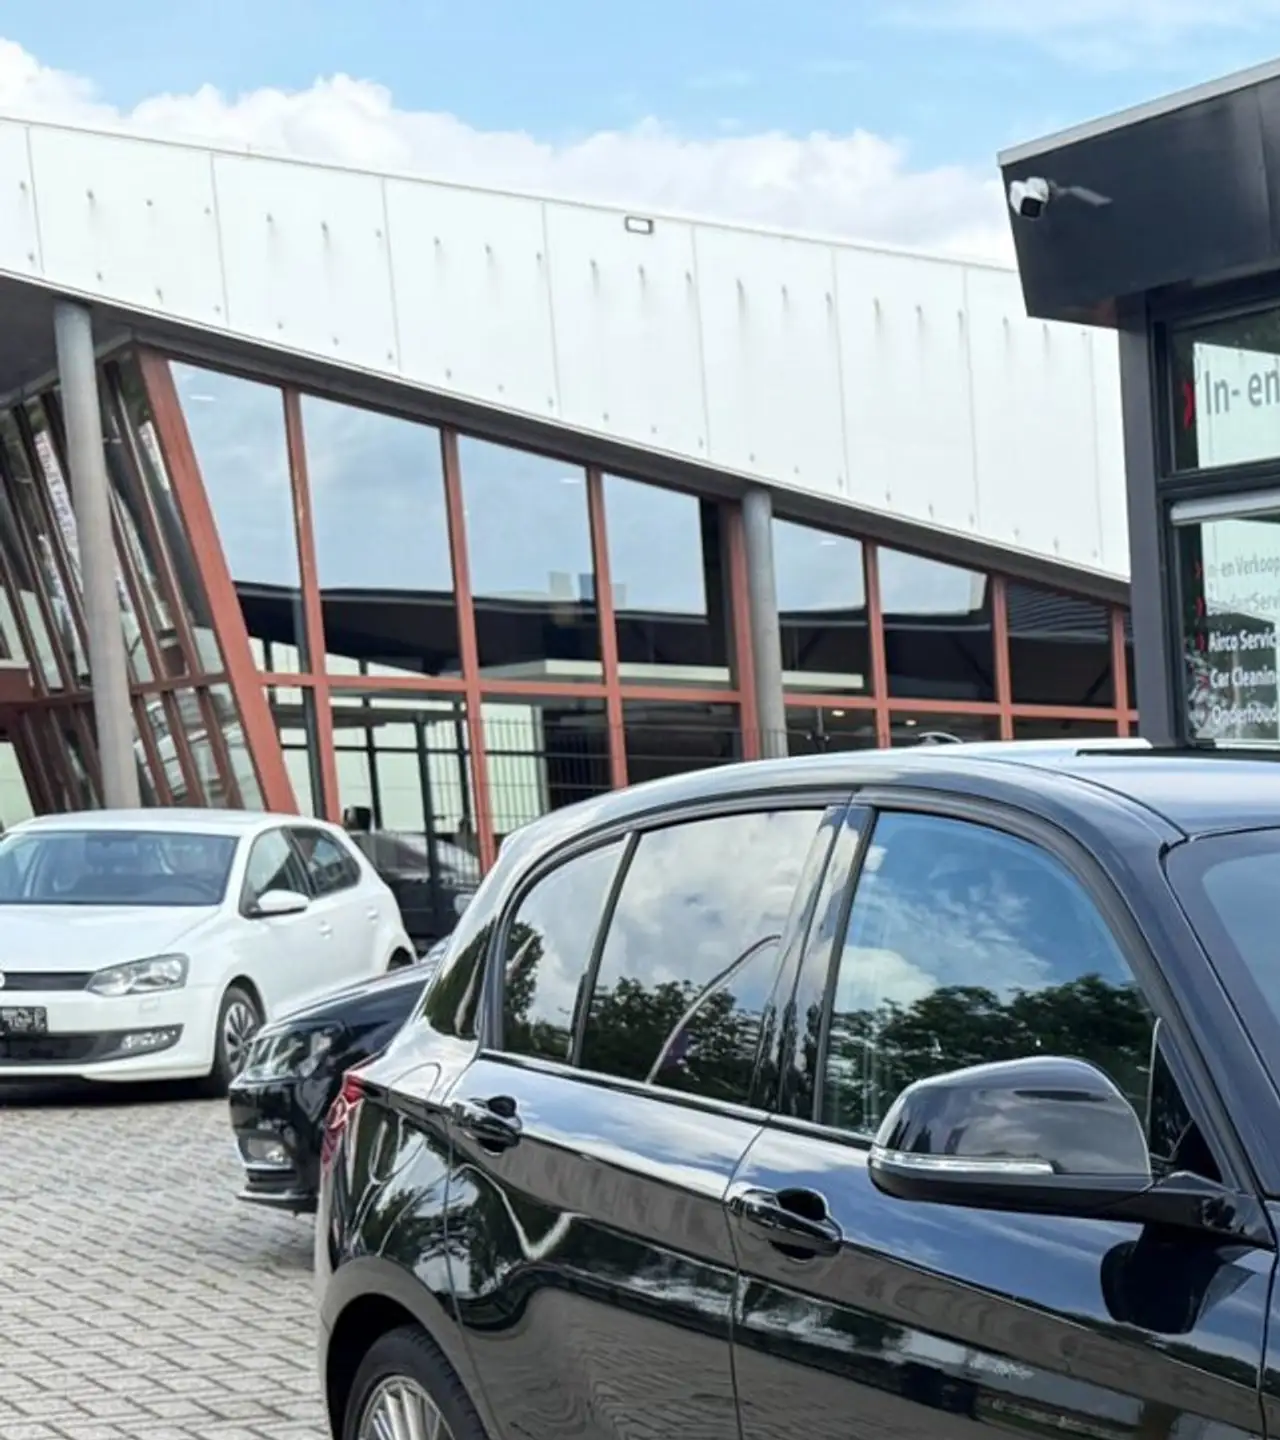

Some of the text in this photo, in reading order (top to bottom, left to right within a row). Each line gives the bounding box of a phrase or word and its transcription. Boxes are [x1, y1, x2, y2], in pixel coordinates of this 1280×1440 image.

[1204, 370, 1240, 415] In-
[1248, 370, 1280, 407] en
[1208, 631, 1239, 653] Airco
[1209, 667, 1230, 688] Car
